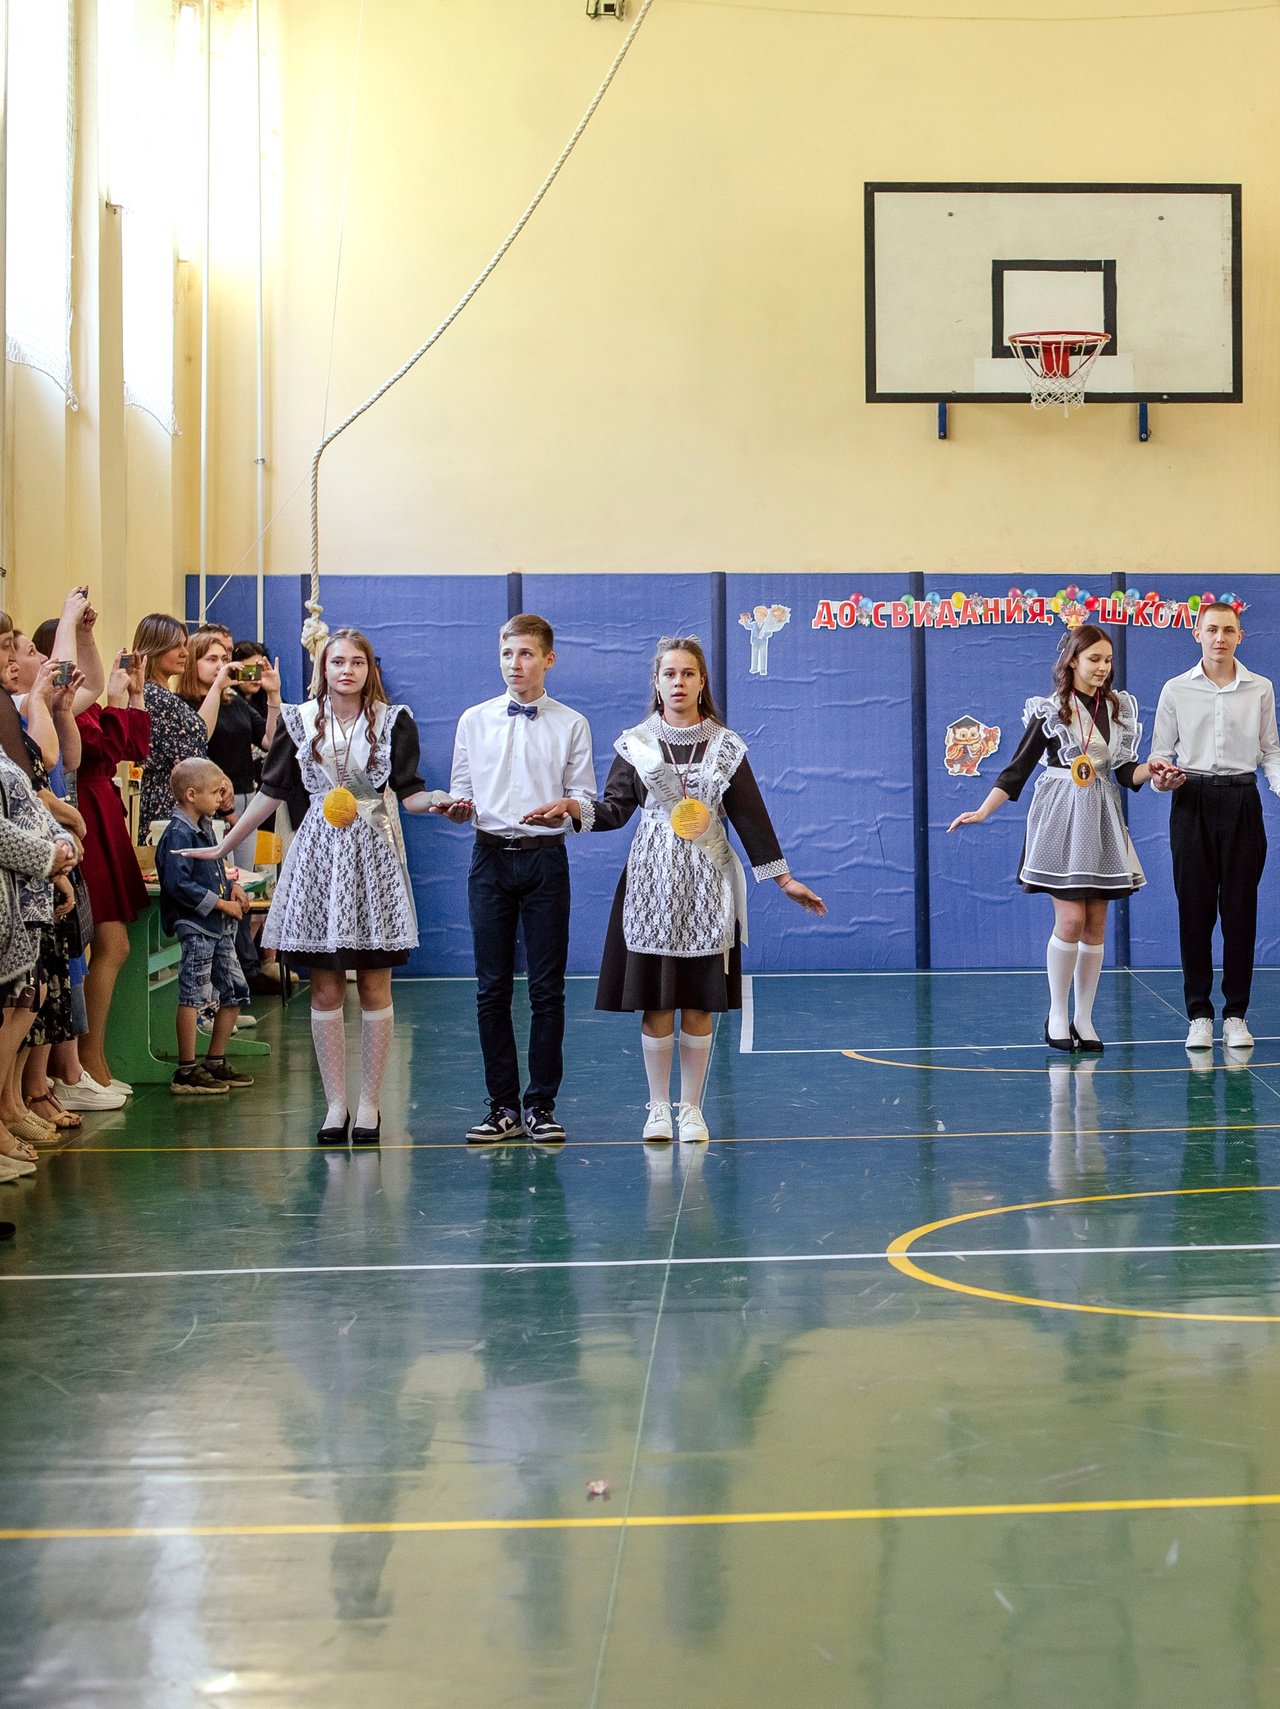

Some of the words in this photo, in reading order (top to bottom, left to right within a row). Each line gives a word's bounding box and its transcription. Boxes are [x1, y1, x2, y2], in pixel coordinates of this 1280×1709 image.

[812, 600, 857, 629] ДО
[872, 598, 1054, 629] СВИДАНИЯ,
[703, 830, 735, 867] 2024
